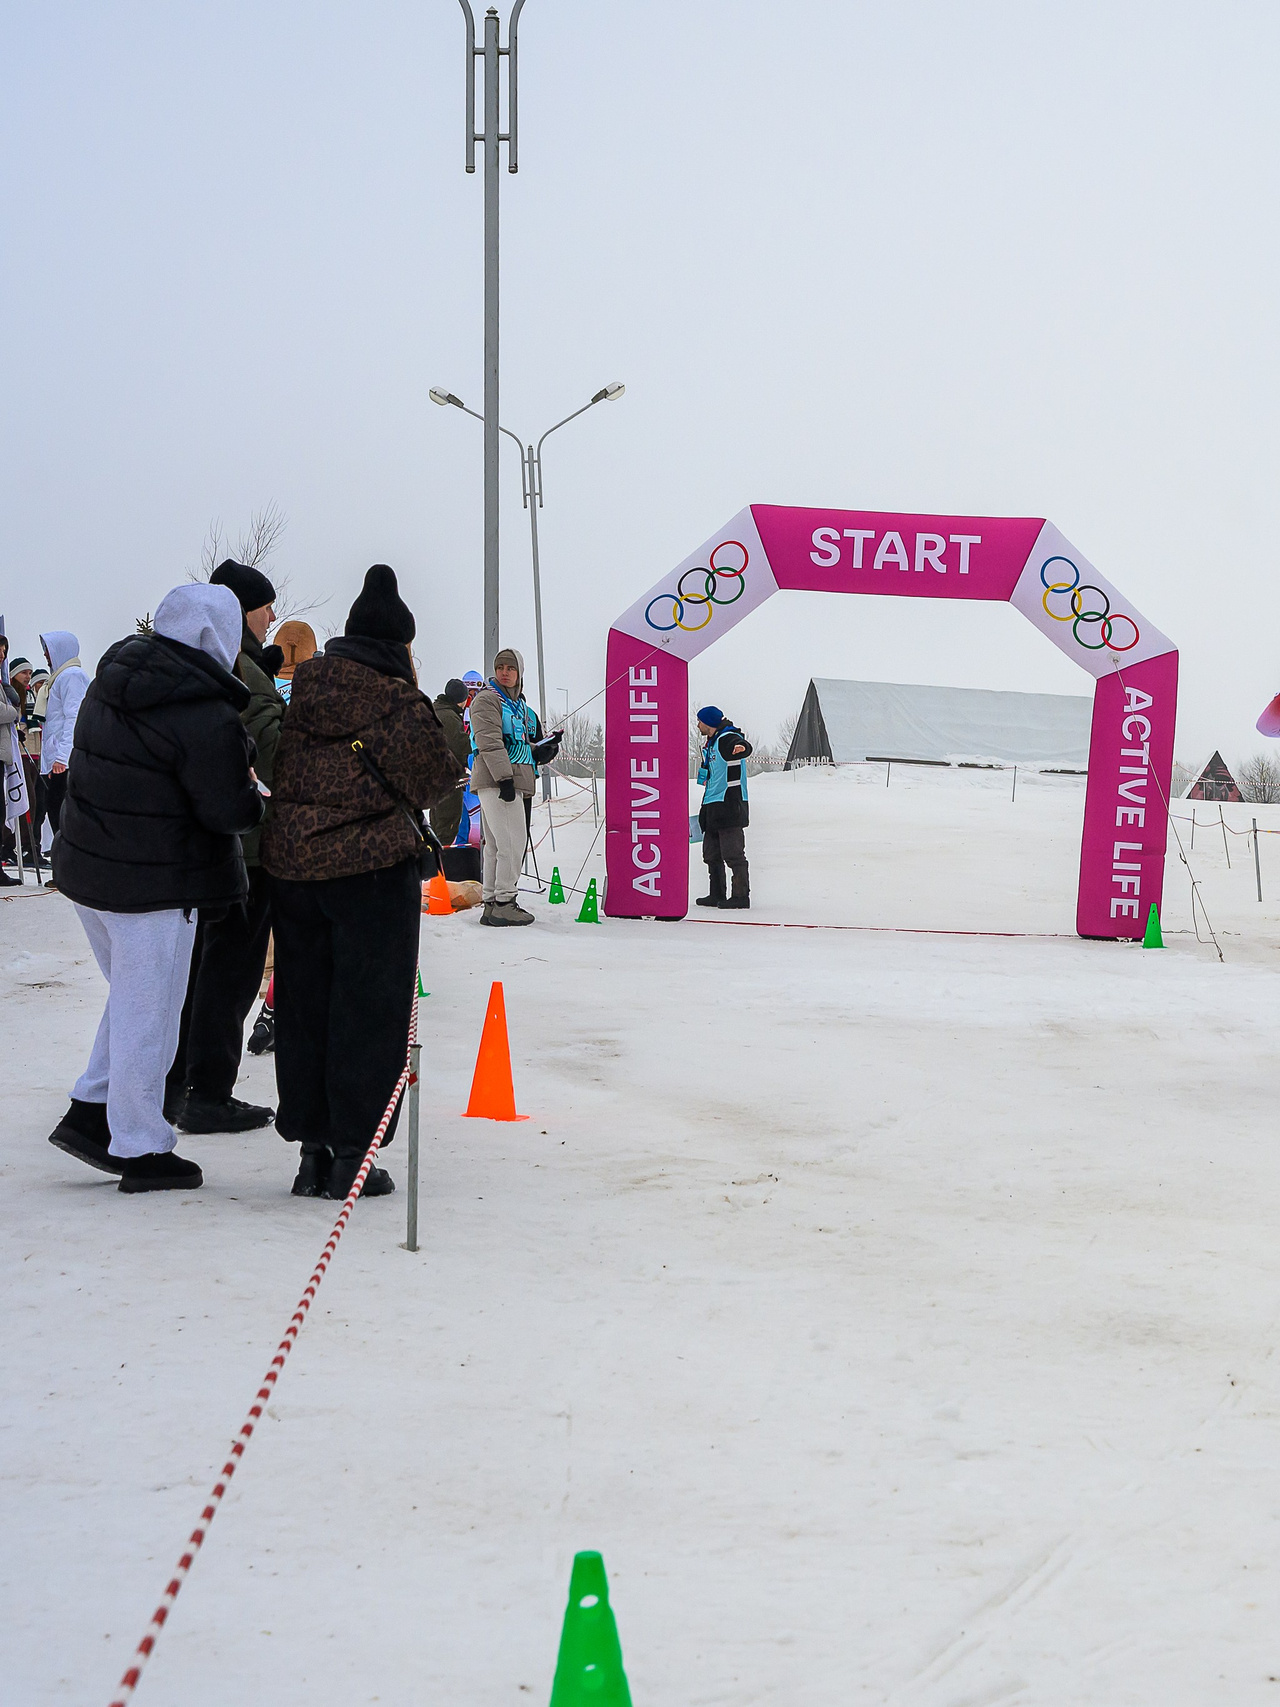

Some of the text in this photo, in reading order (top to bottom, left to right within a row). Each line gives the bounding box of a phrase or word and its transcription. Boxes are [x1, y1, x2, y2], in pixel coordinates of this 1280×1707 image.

[810, 527, 981, 574] START
[629, 666, 661, 896] ACTIVE LIFE
[1110, 686, 1153, 919] ACTIVE LIFE
